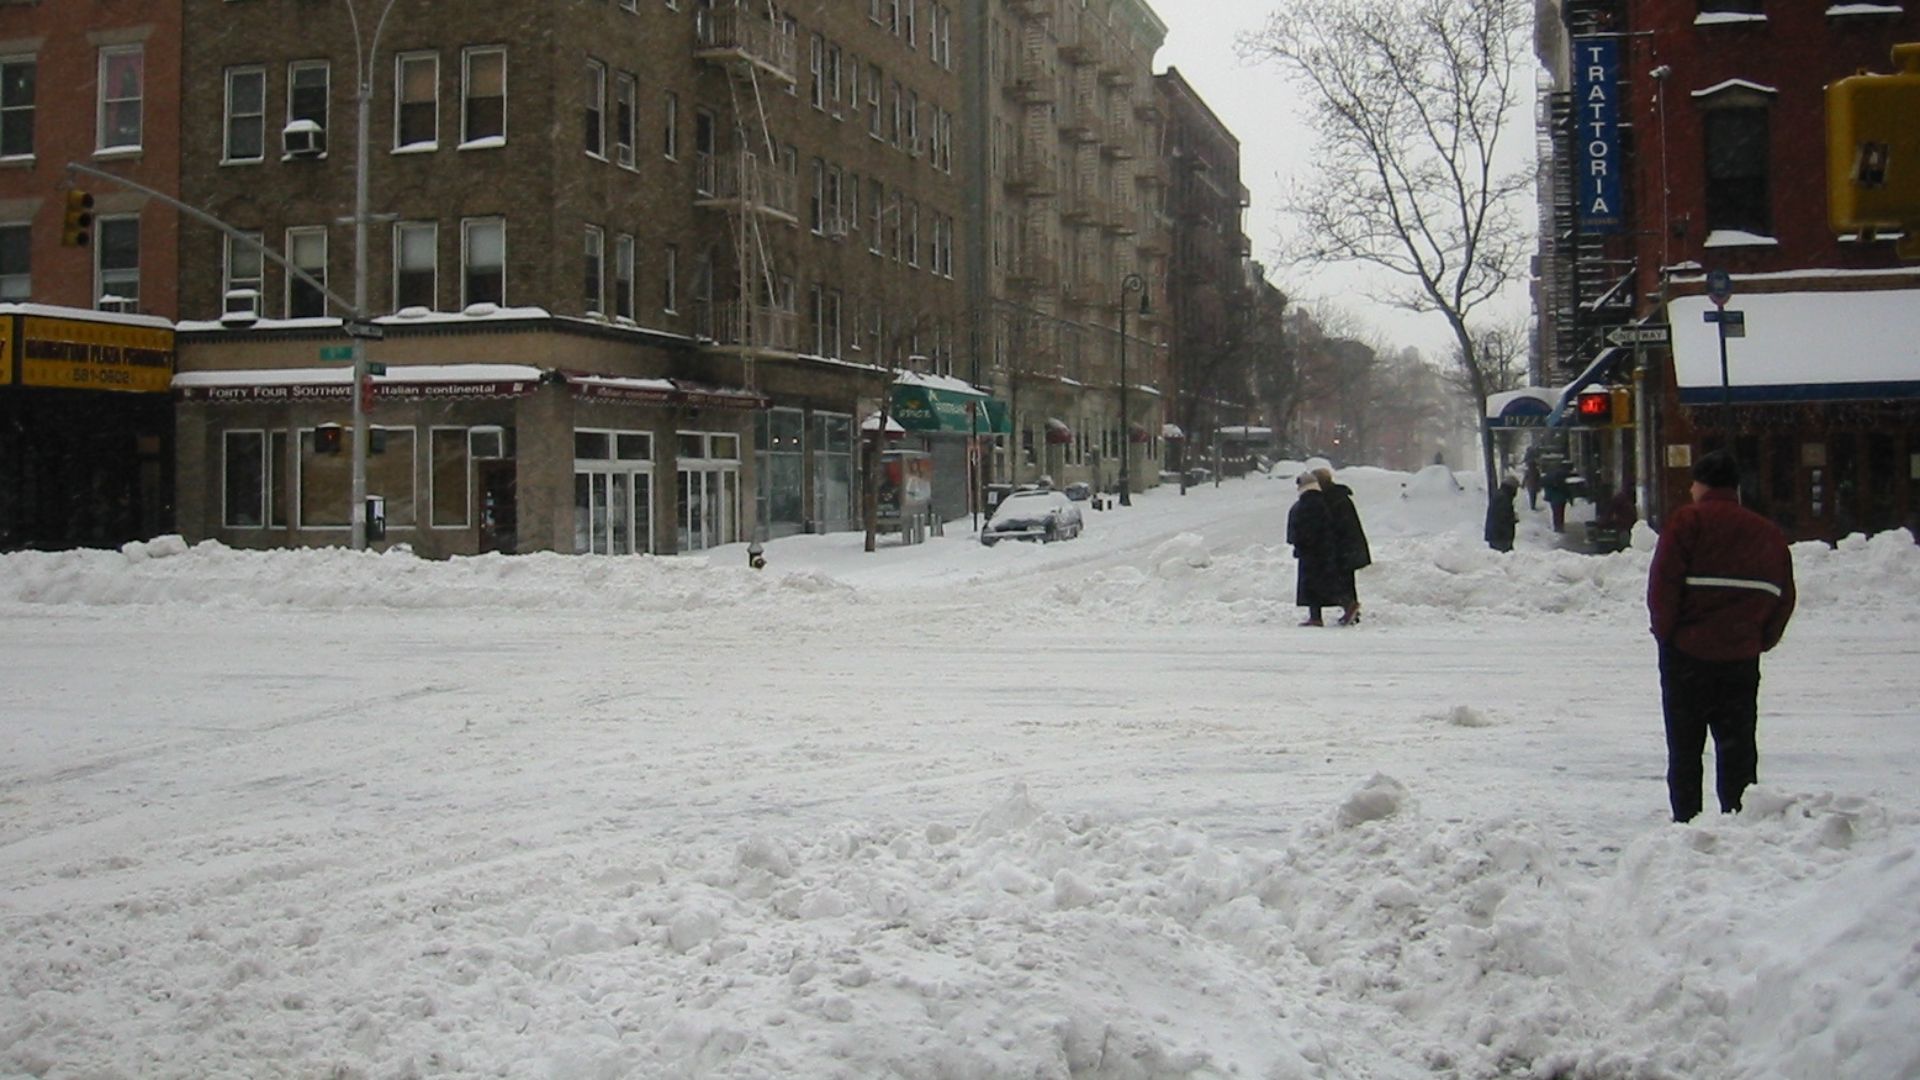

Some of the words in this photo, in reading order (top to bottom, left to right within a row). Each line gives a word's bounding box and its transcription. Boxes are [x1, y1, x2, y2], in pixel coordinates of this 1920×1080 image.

[1588, 47, 1609, 213] TRATTORIA
[1641, 330, 1665, 340] WAY
[425, 384, 496, 395] continental
